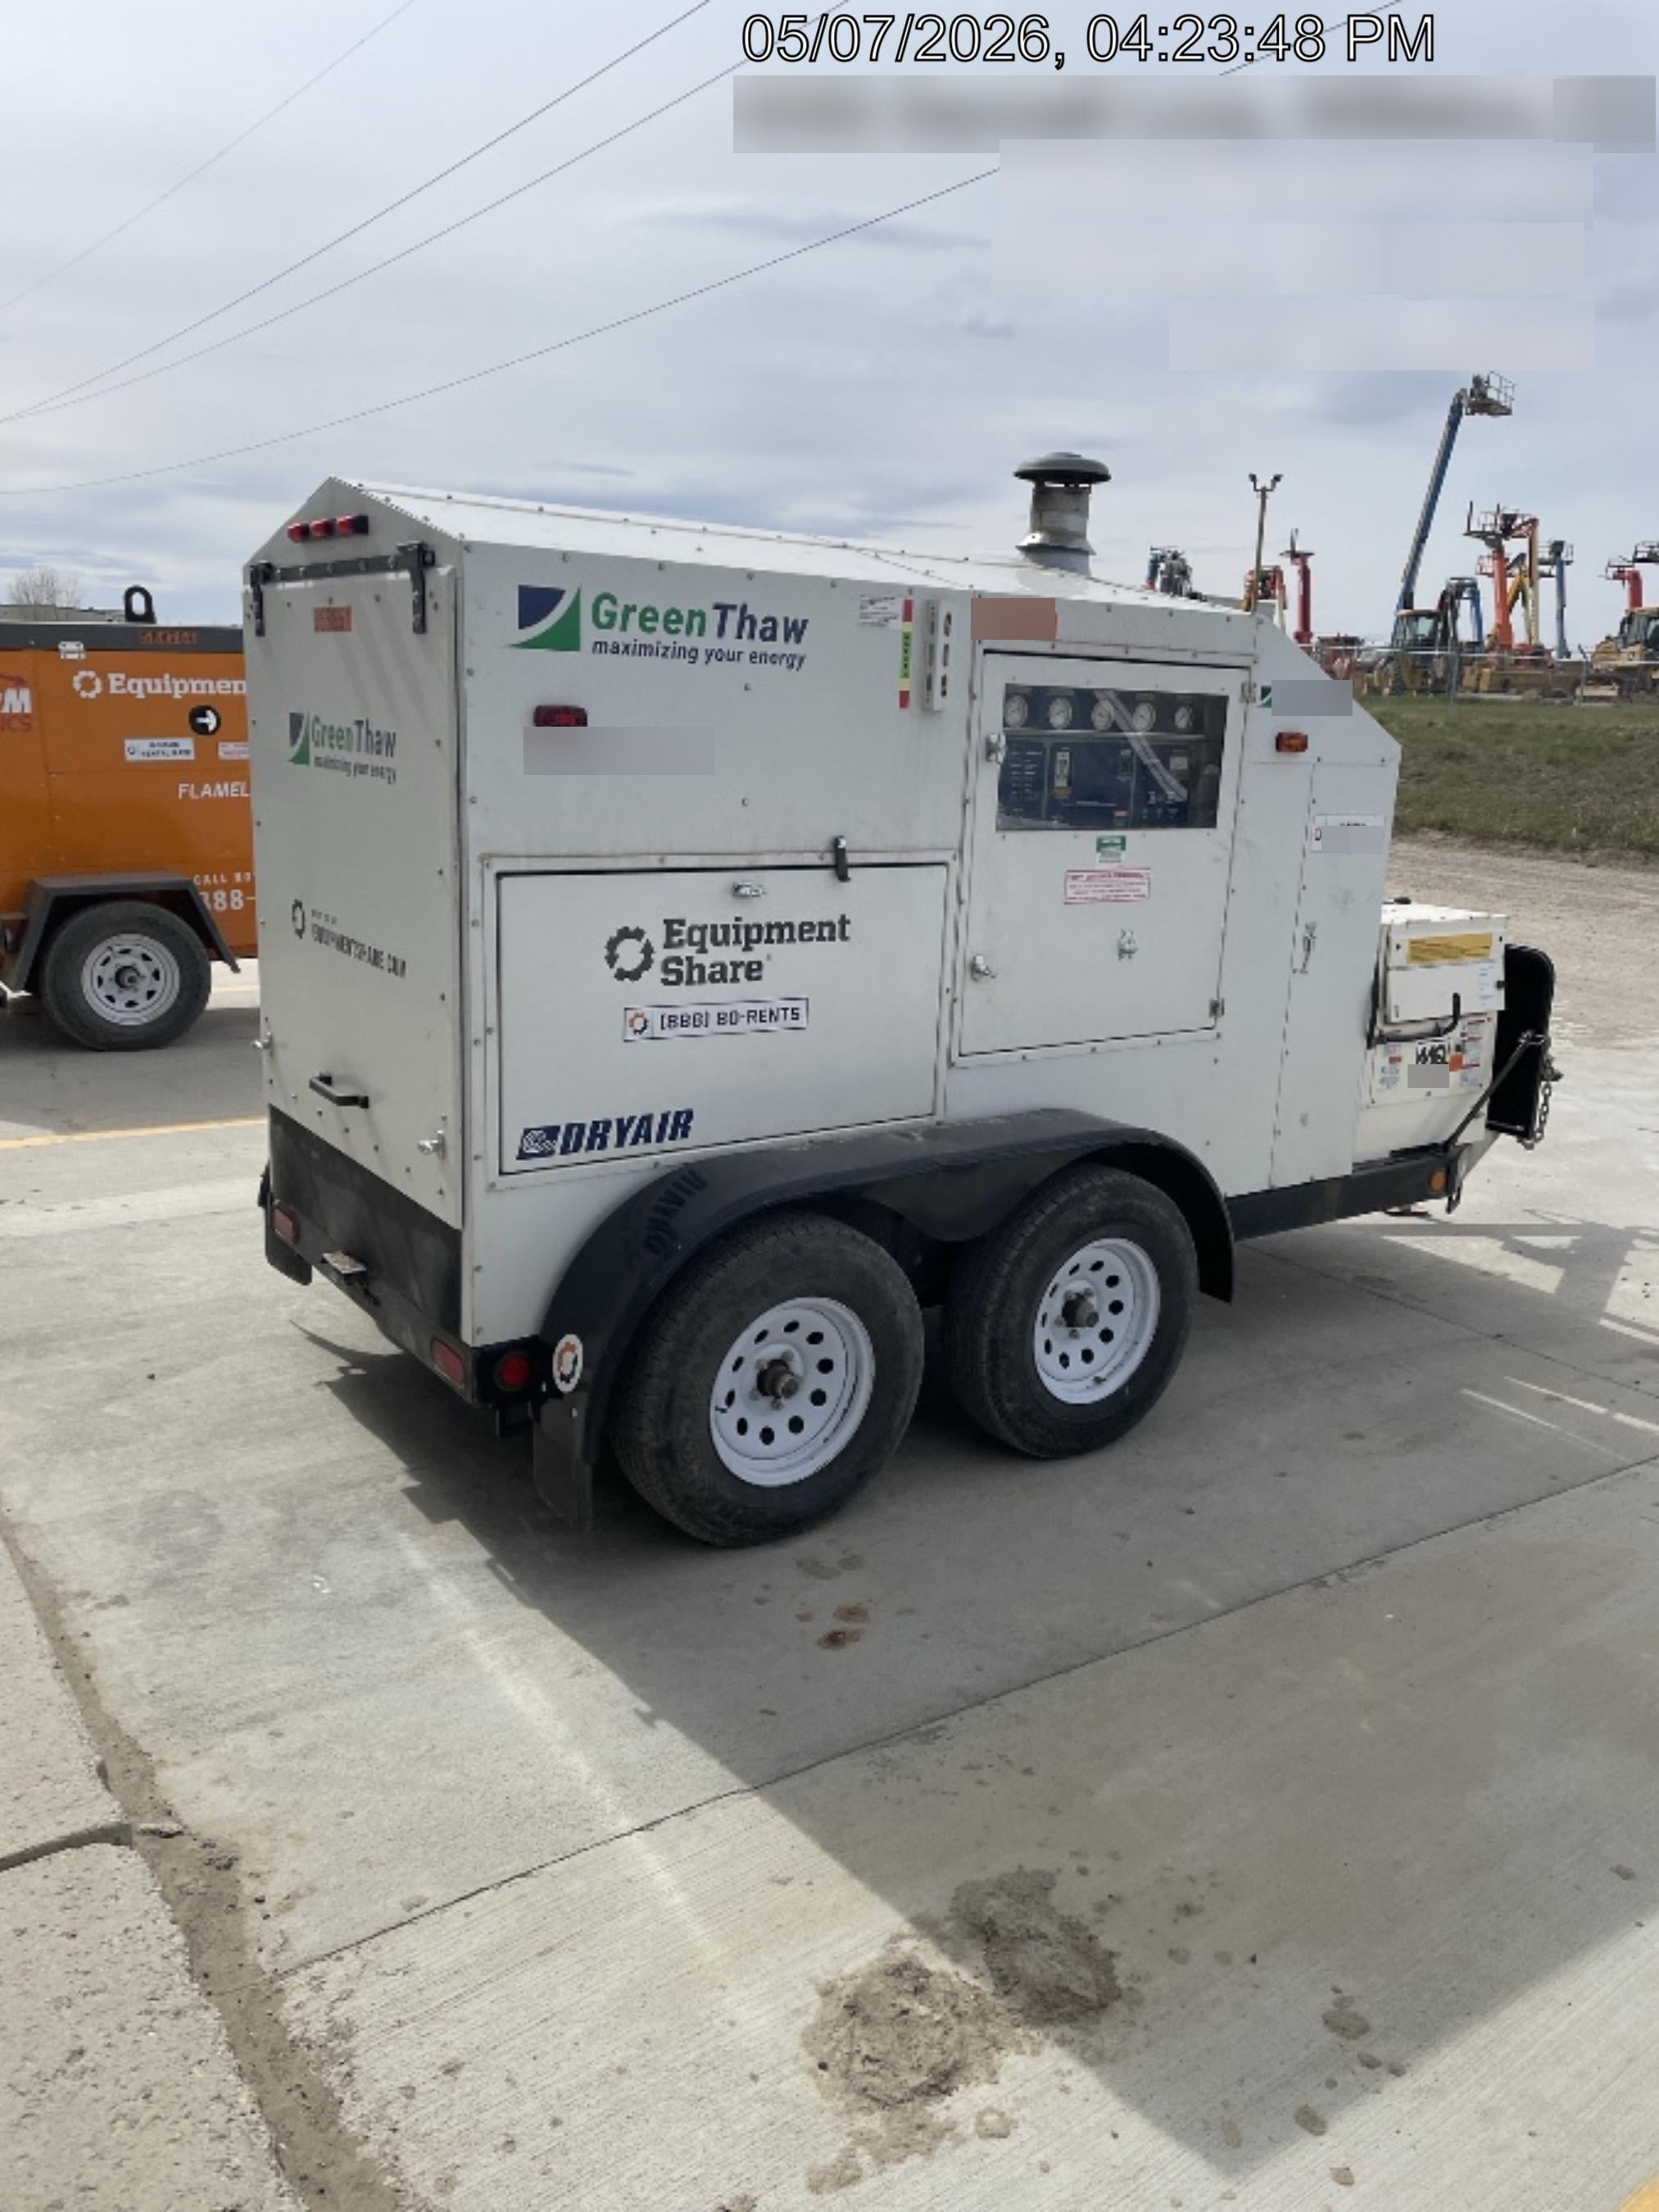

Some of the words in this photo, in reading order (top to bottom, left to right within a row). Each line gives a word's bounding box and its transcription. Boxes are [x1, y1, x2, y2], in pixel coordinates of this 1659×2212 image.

[591, 592, 809, 645] GreenThaw
[592, 638, 699, 665] maximizing
[705, 647, 744, 665] your
[749, 650, 807, 672] energy
[0, 687, 33, 714] M
[312, 714, 397, 758] GreenThaw
[233, 871, 256, 883] NO
[662, 913, 851, 954] Equipment
[660, 954, 764, 986] Share
[560, 1108, 695, 1156] DRYAIR
